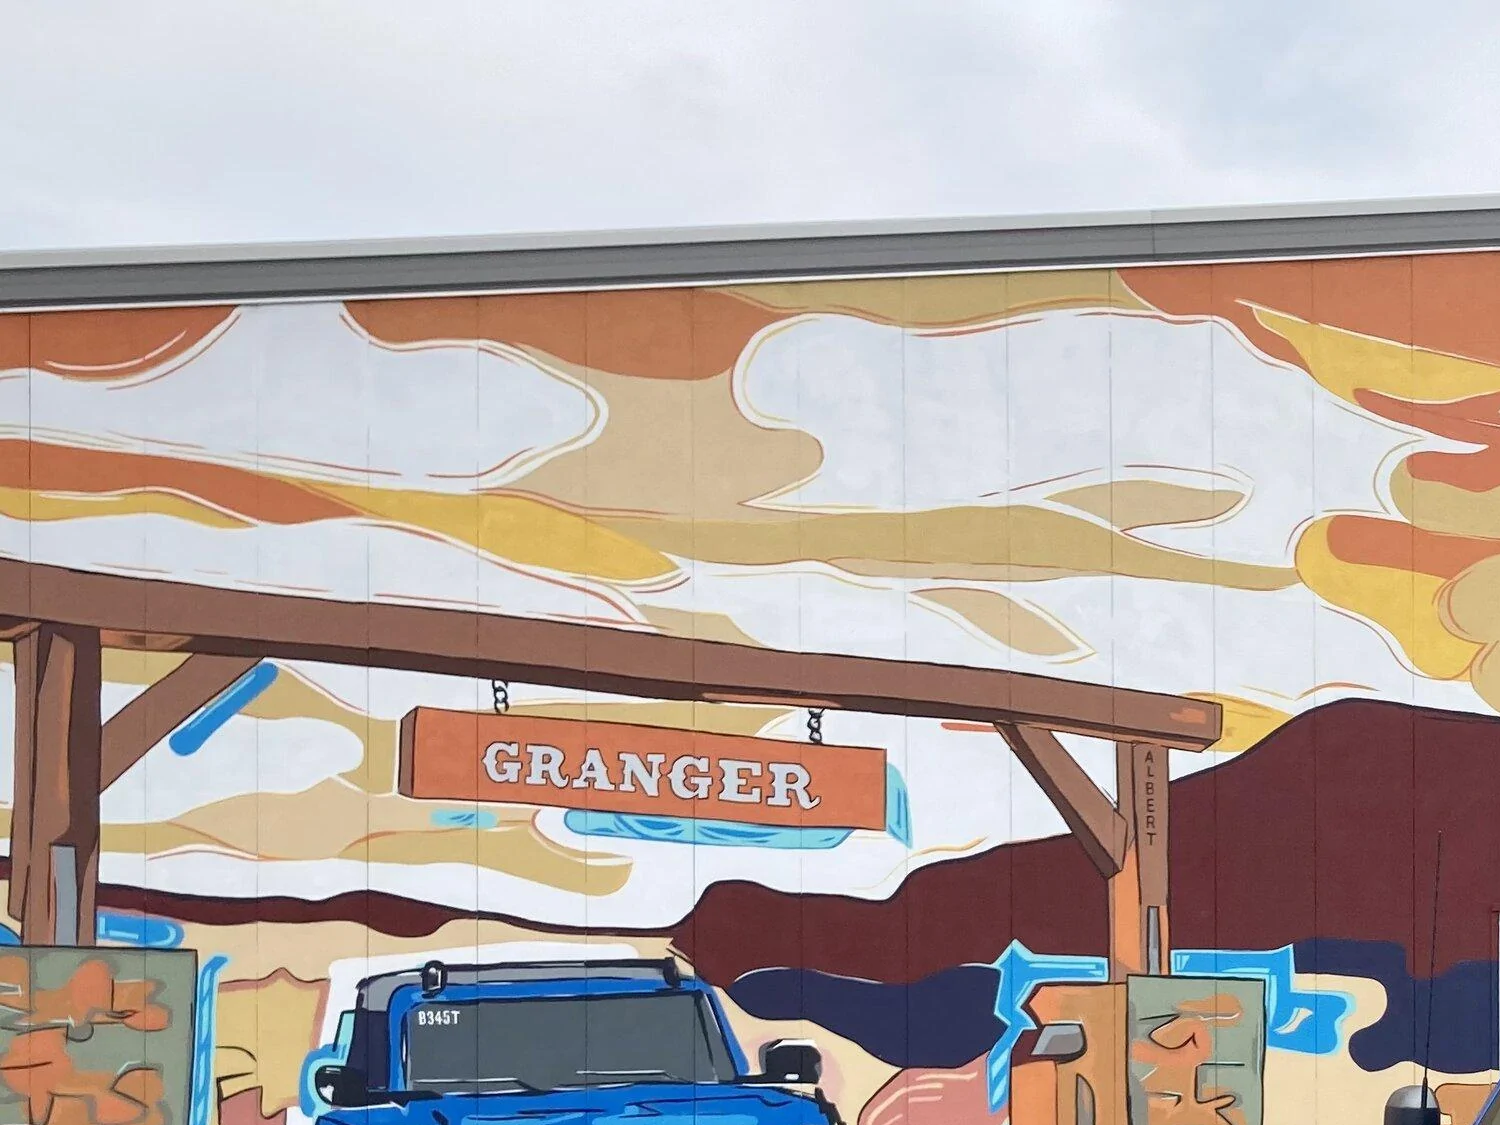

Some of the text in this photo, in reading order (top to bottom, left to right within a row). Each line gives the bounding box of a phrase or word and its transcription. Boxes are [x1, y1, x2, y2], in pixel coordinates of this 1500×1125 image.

[481, 741, 822, 810] GRANGER
[1144, 751, 1157, 846] ALBERT
[418, 1010, 461, 1025] B345T
